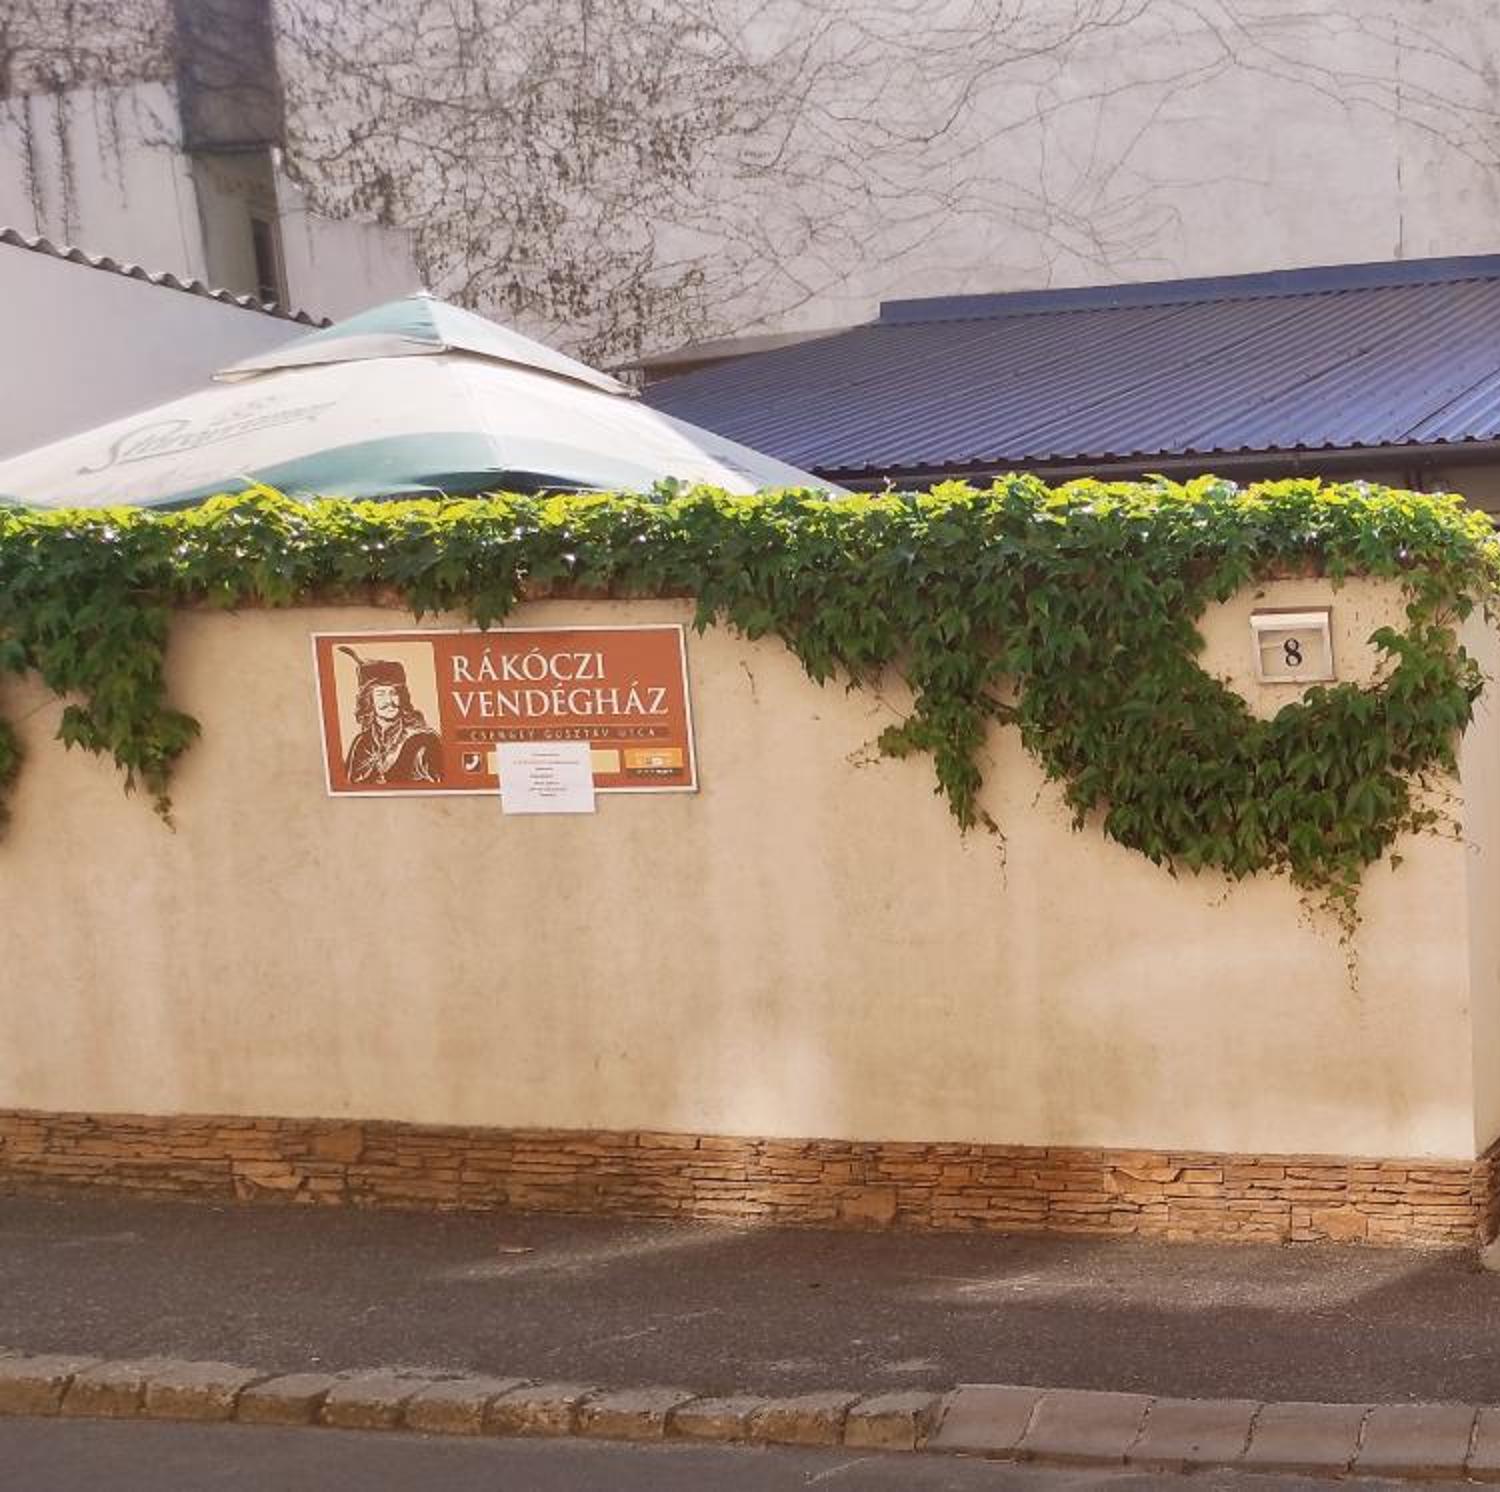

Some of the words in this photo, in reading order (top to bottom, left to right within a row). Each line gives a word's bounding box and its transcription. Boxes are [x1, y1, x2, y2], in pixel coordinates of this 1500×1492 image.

[451, 648, 604, 682] RÁKÓCZI
[1284, 637, 1302, 667] 8
[452, 680, 669, 718] VENDÉGHÁZ
